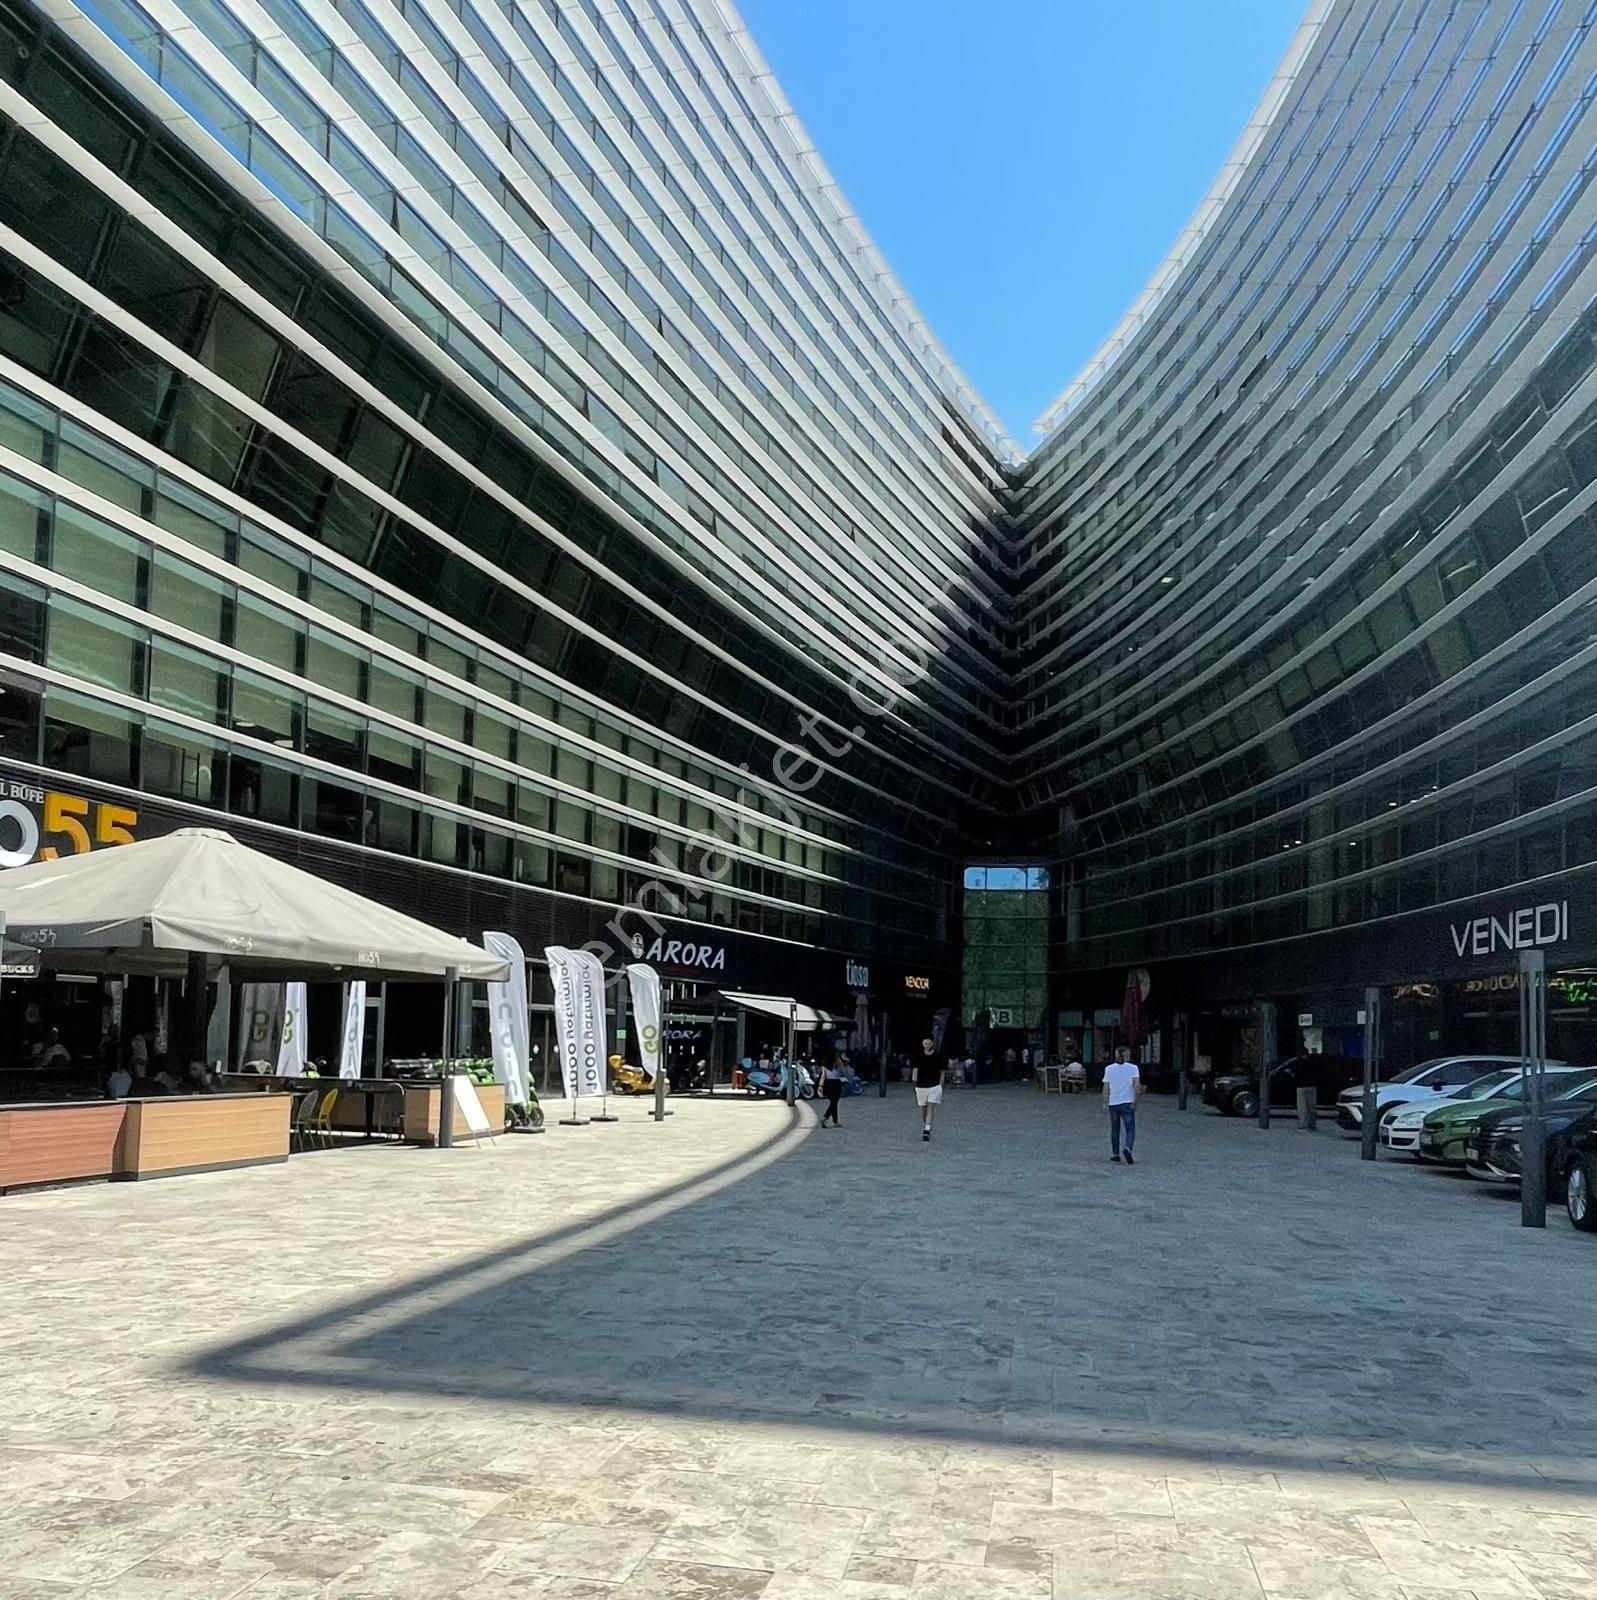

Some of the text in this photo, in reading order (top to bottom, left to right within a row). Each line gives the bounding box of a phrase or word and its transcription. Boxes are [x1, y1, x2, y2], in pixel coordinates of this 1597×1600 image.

[1450, 900, 1568, 956] VENEDI
[645, 937, 725, 970] ARORA
[998, 1011, 1009, 1023] B
